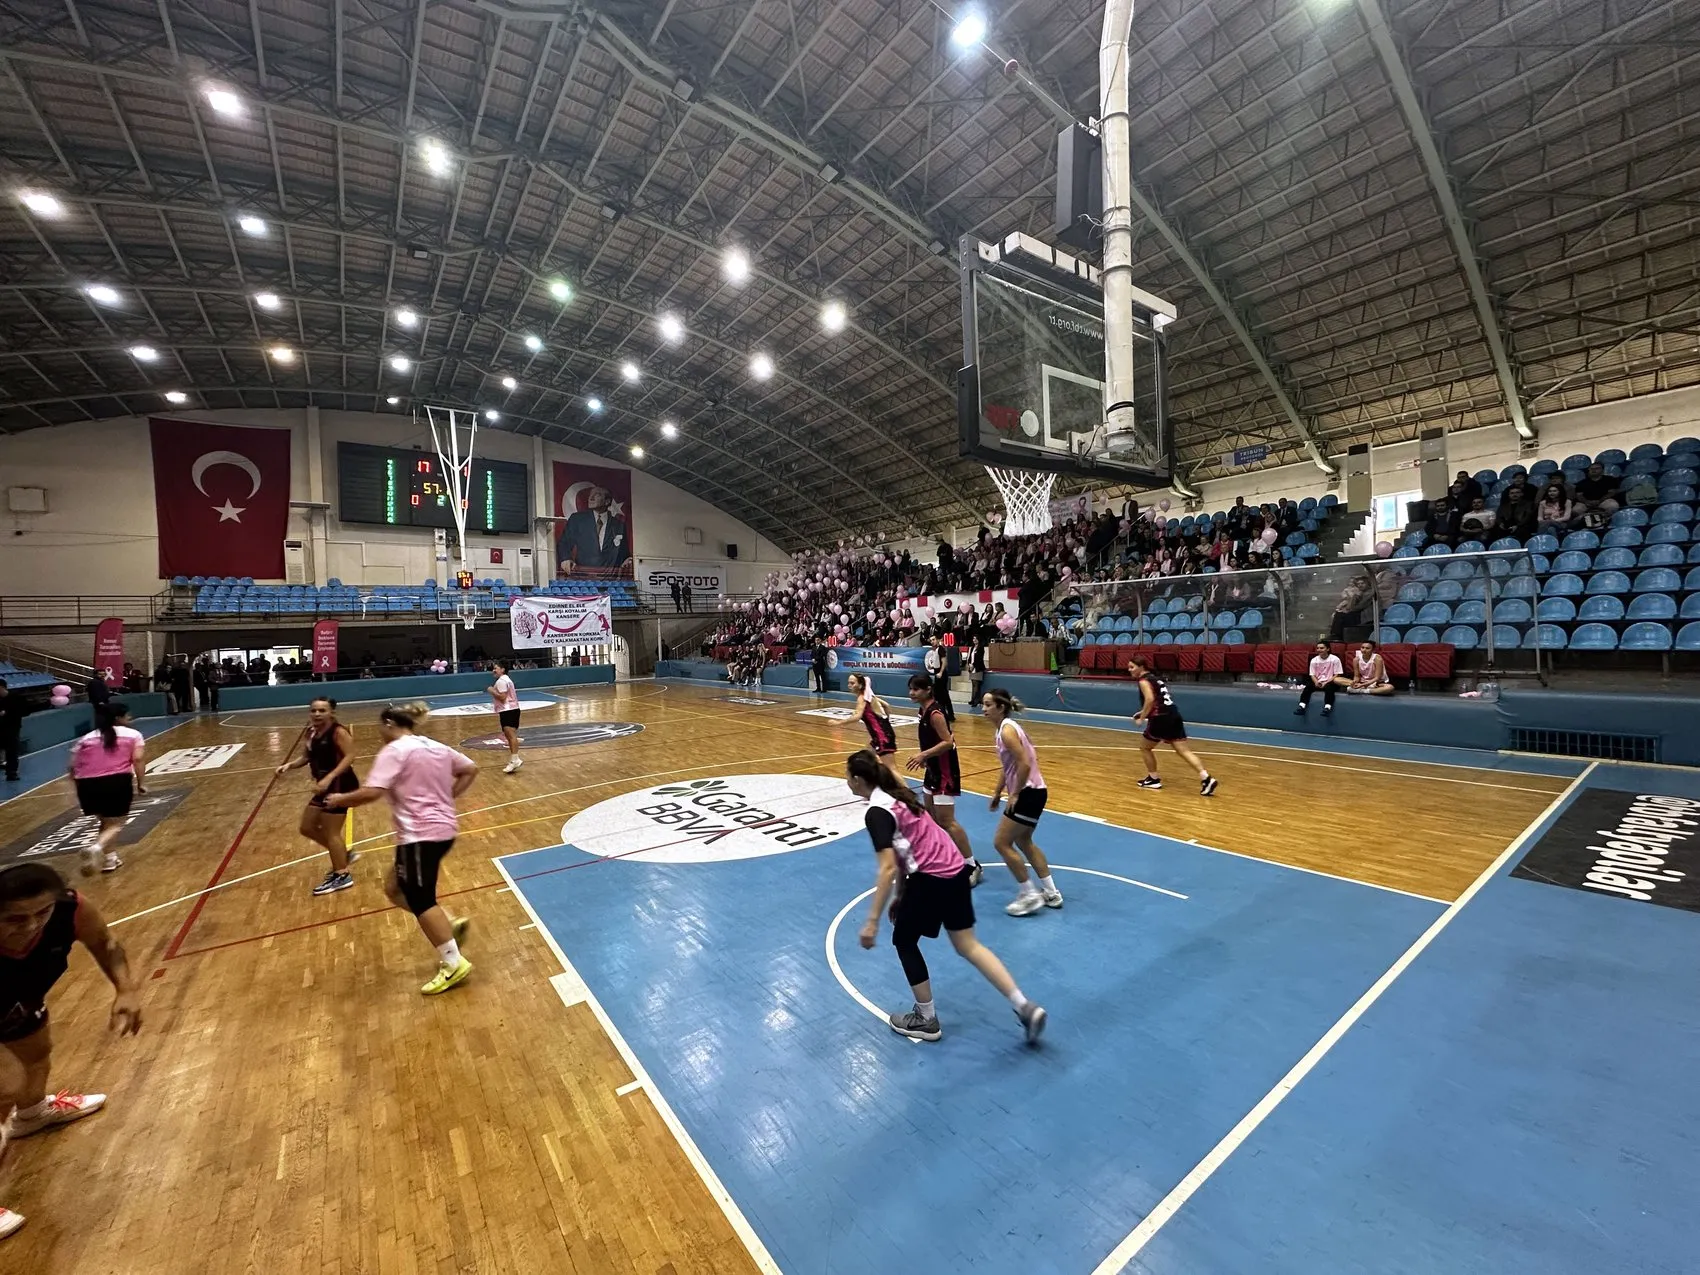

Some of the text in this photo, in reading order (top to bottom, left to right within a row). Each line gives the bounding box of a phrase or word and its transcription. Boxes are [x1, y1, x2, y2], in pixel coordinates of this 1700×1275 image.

[417, 460, 430, 473] 17
[411, 494, 419, 505] 0
[437, 494, 445, 506] 2
[462, 578, 472, 587] 14
[943, 632, 955, 647] 00
[691, 792, 839, 847] Garanti
